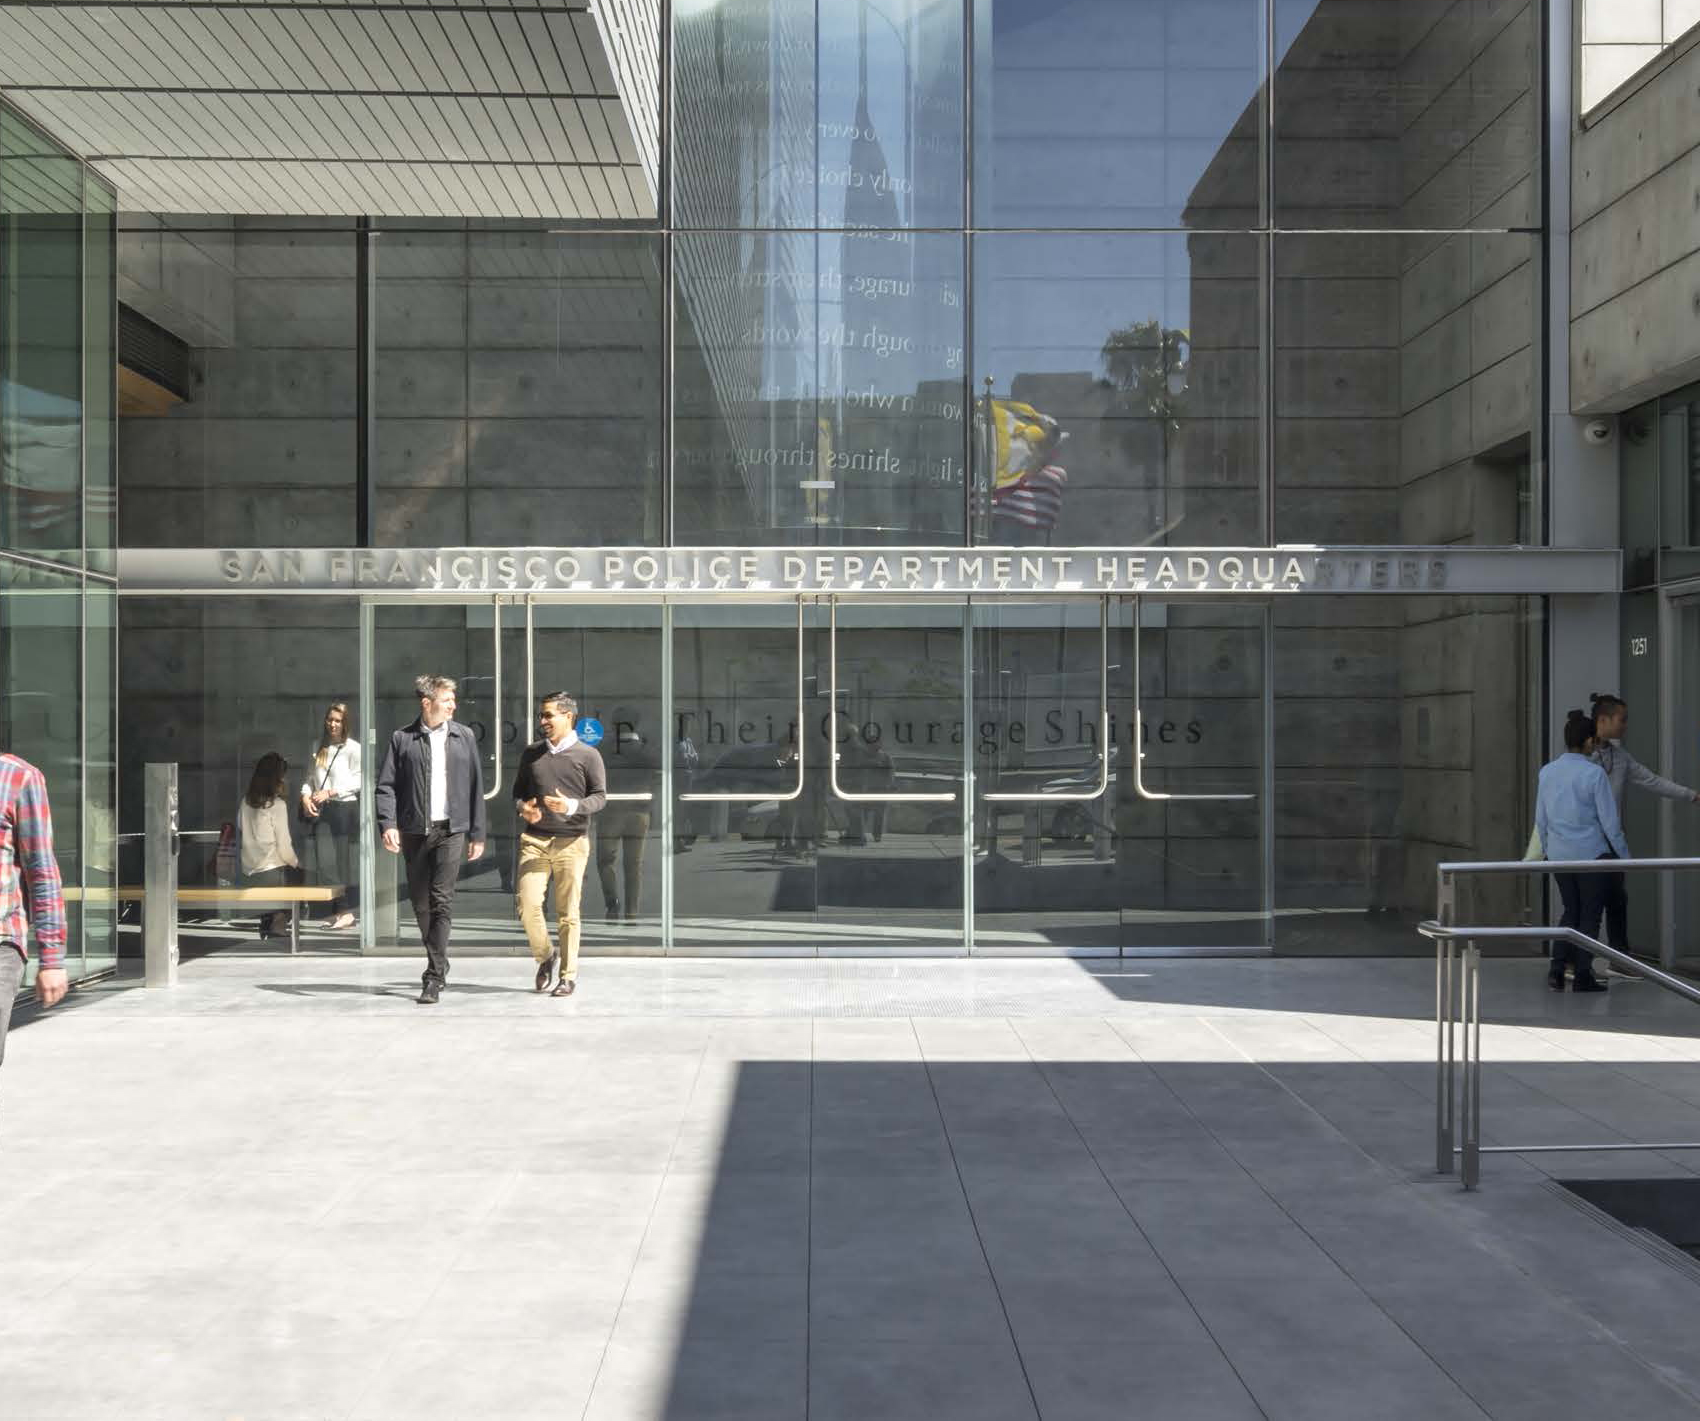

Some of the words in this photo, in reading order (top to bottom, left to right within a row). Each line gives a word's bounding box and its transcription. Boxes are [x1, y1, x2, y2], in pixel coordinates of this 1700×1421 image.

[222, 556, 306, 584] SAN
[330, 555, 583, 583] FRANCISCO
[603, 555, 761, 583] POLICE
[782, 555, 1073, 583] DEPARTMENT
[1096, 555, 1450, 589] HEADQUARTERS
[1631, 637, 1648, 657] 1251
[673, 709, 802, 745] Their
[821, 710, 1027, 755] Courage
[1044, 709, 1203, 745] Shines
